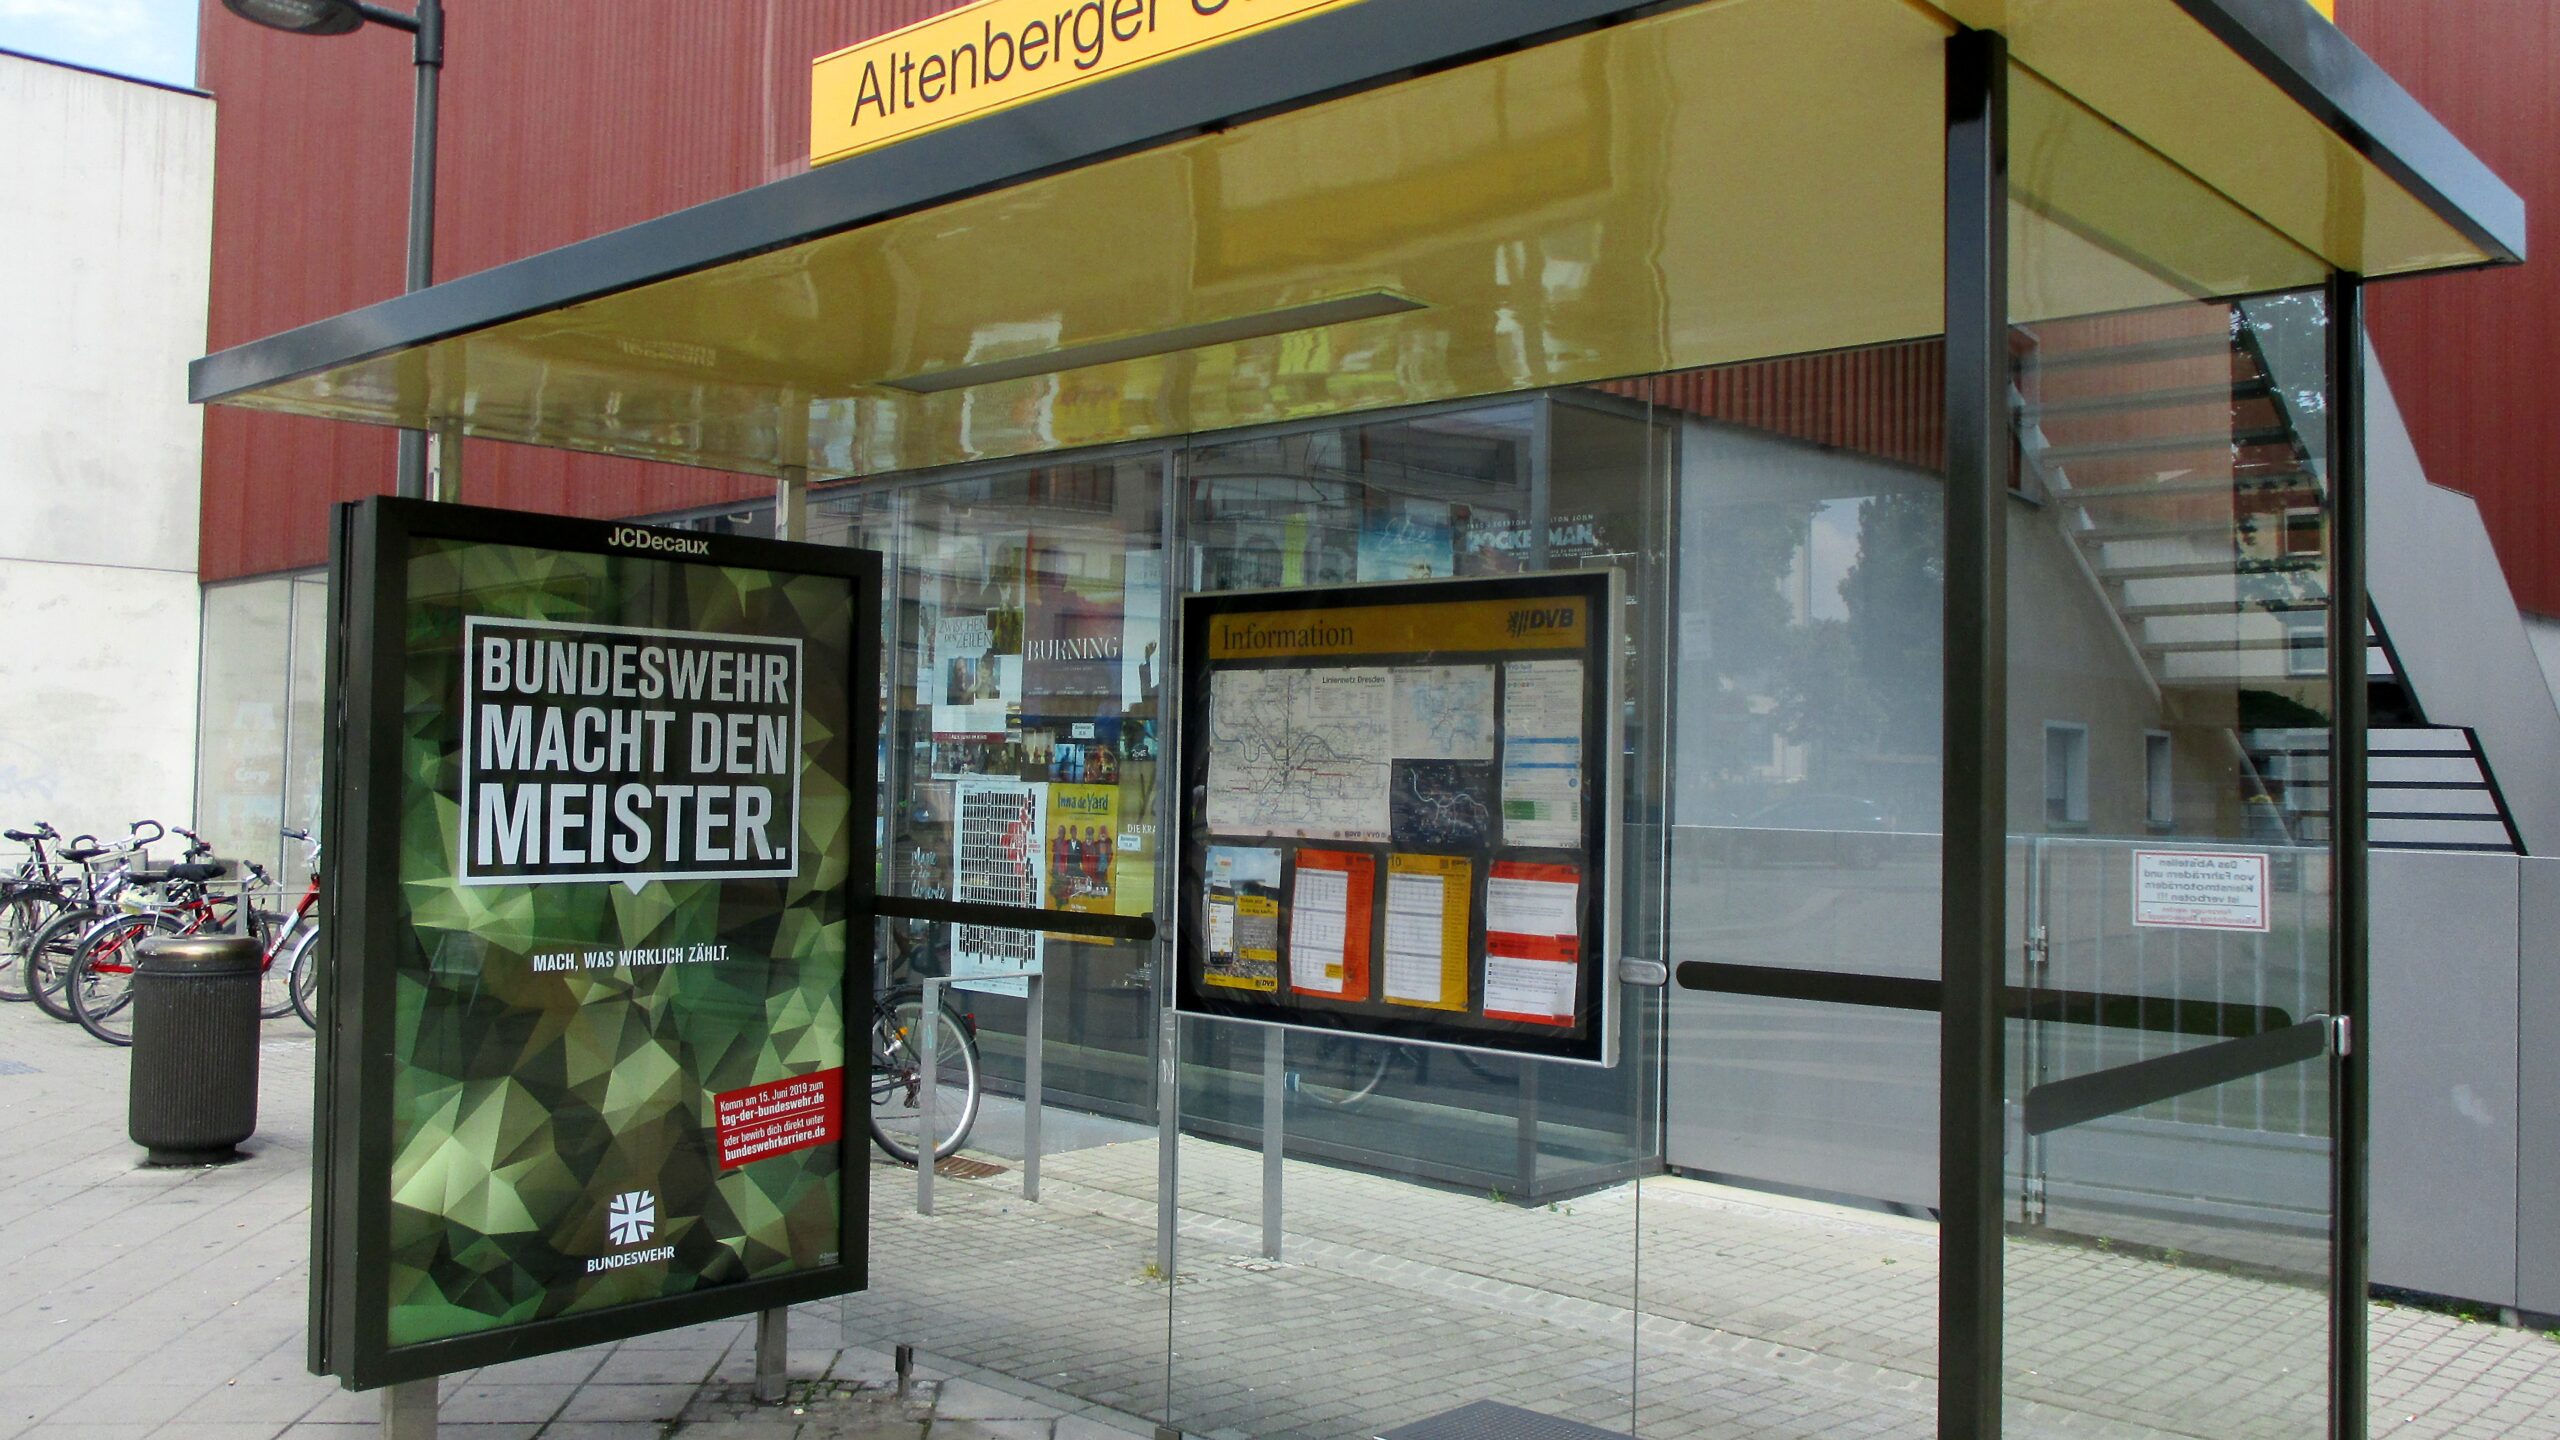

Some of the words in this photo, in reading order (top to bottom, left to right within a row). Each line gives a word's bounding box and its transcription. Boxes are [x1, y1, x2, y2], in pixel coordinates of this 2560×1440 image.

[608, 527, 710, 556] JCDecaux
[1466, 523, 1593, 554] ROCKEMAN
[938, 617, 987, 634] ZWISCHEN
[1530, 608, 1575, 629] DVB
[956, 631, 993, 649] ZEILEN
[1027, 636, 1119, 661] BURNING
[1223, 619, 1354, 650] Information
[482, 637, 789, 704] BUNDESWEHR
[1357, 675, 1386, 684] Dresden
[480, 704, 676, 774] MACHT
[690, 712, 788, 776] DEN
[1087, 792, 1109, 812] Yard
[477, 782, 787, 866] MEISTER.
[1127, 823, 1141, 834] DIE
[1391, 856, 1401, 867] 10
[533, 952, 579, 973] MACH,
[583, 950, 615, 969] WAS
[619, 947, 685, 967] WIRKLICH
[688, 942, 730, 963] ZÄHLT.
[720, 1100, 744, 1113] Komm
[745, 1096, 757, 1107] am
[759, 1092, 770, 1103] 15.
[772, 1088, 788, 1101] Juni
[790, 1082, 808, 1097] 2019
[809, 1081, 824, 1092] zum
[721, 1092, 825, 1127] tag-der-bundeswehr.de
[723, 1134, 740, 1148] oder
[741, 1128, 766, 1143] bewirb
[766, 1123, 783, 1138] dich
[783, 1118, 805, 1132] direkt
[805, 1115, 825, 1127] unter
[724, 1126, 826, 1161] bundeswehrkarriere.de
[587, 1246, 675, 1273] BUNDESWEHR
